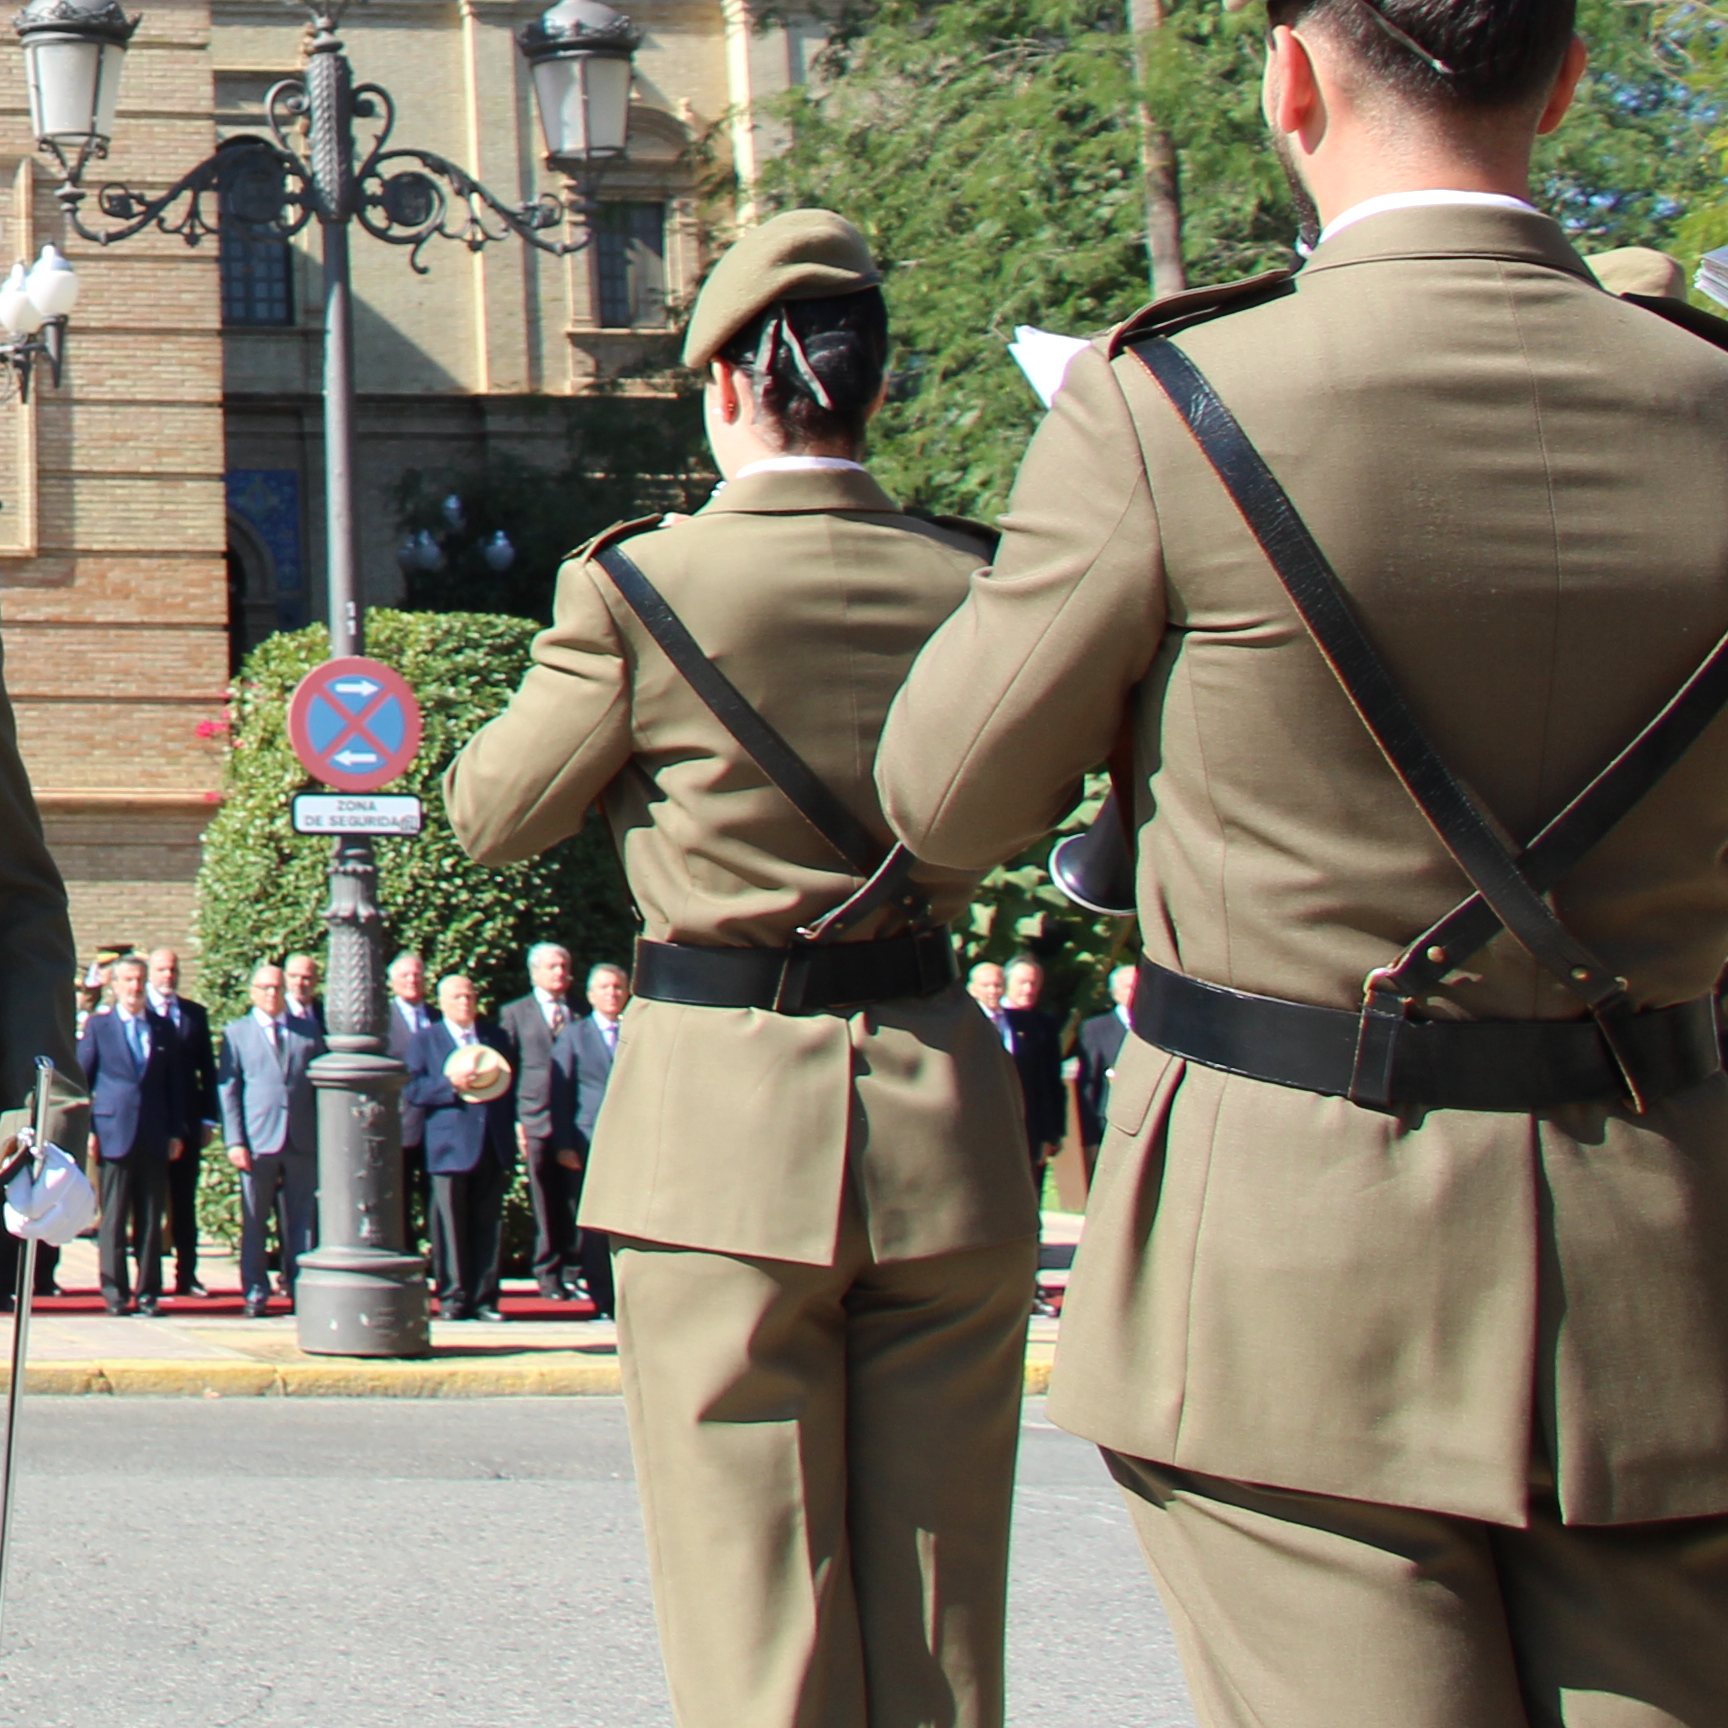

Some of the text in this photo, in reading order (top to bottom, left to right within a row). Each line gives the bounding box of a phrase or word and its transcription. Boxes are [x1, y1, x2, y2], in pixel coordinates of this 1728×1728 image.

[337, 800, 378, 812] ZONA
[304, 815, 324, 827] DE
[329, 815, 402, 827] SEGURIDA
